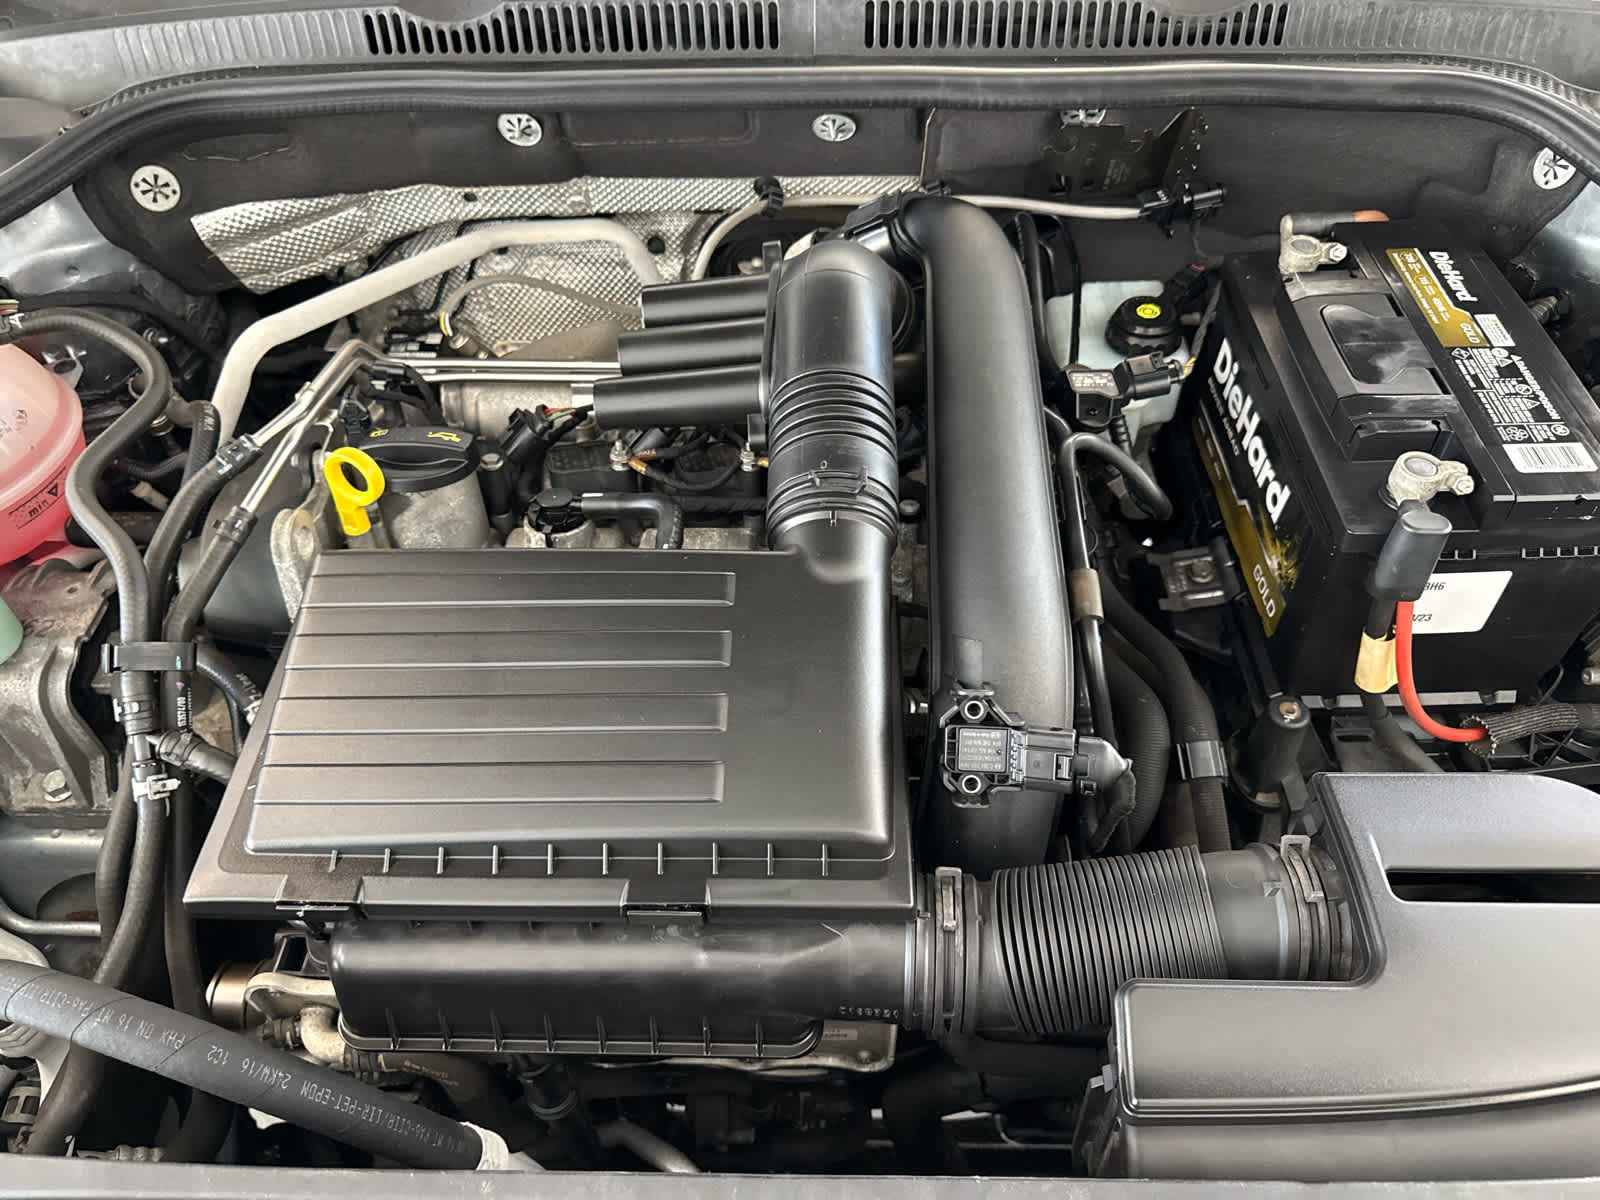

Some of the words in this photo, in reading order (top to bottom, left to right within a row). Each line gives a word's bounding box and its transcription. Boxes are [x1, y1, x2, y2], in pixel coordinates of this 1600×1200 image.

[1428, 251, 1478, 301] DieHard
[1460, 322, 1481, 343] GOLD
[1213, 337, 1291, 524] DieHard
[28, 499, 48, 517] min
[1253, 563, 1276, 617] GOLD
